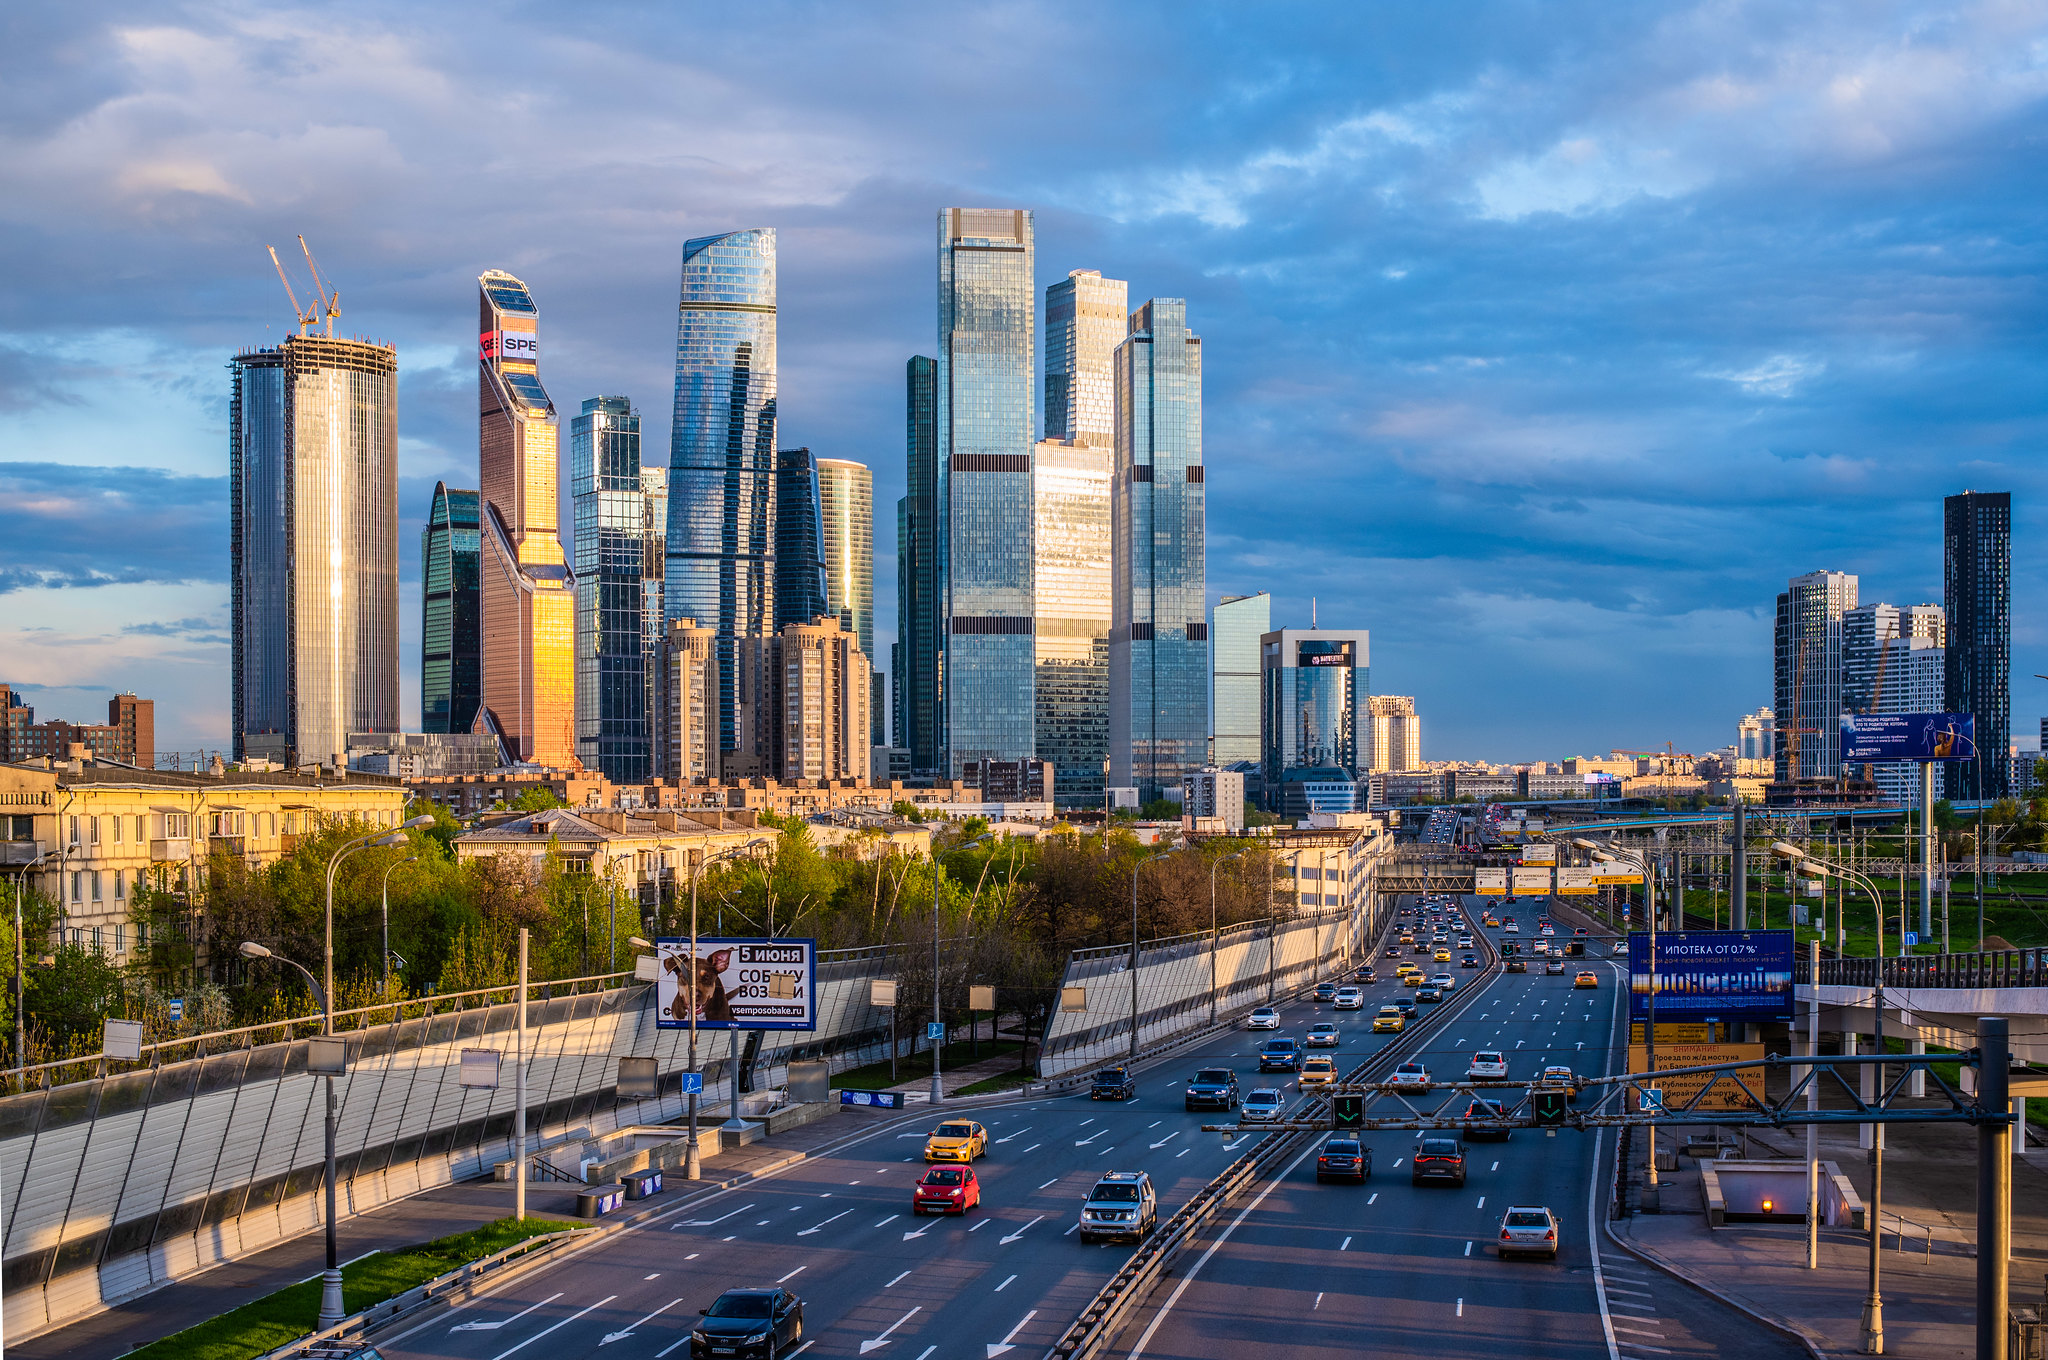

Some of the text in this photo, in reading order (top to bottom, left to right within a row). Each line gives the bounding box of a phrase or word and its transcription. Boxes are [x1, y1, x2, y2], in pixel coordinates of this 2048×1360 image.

[742, 947, 751, 962] 5
[1665, 946, 1713, 954] ИПОТЕКА
[1715, 945, 1729, 954] ОТ
[739, 969, 804, 983] СОБУ
[739, 985, 804, 998] ВОЗИ
[732, 1006, 802, 1016] vsemposobake.ru
